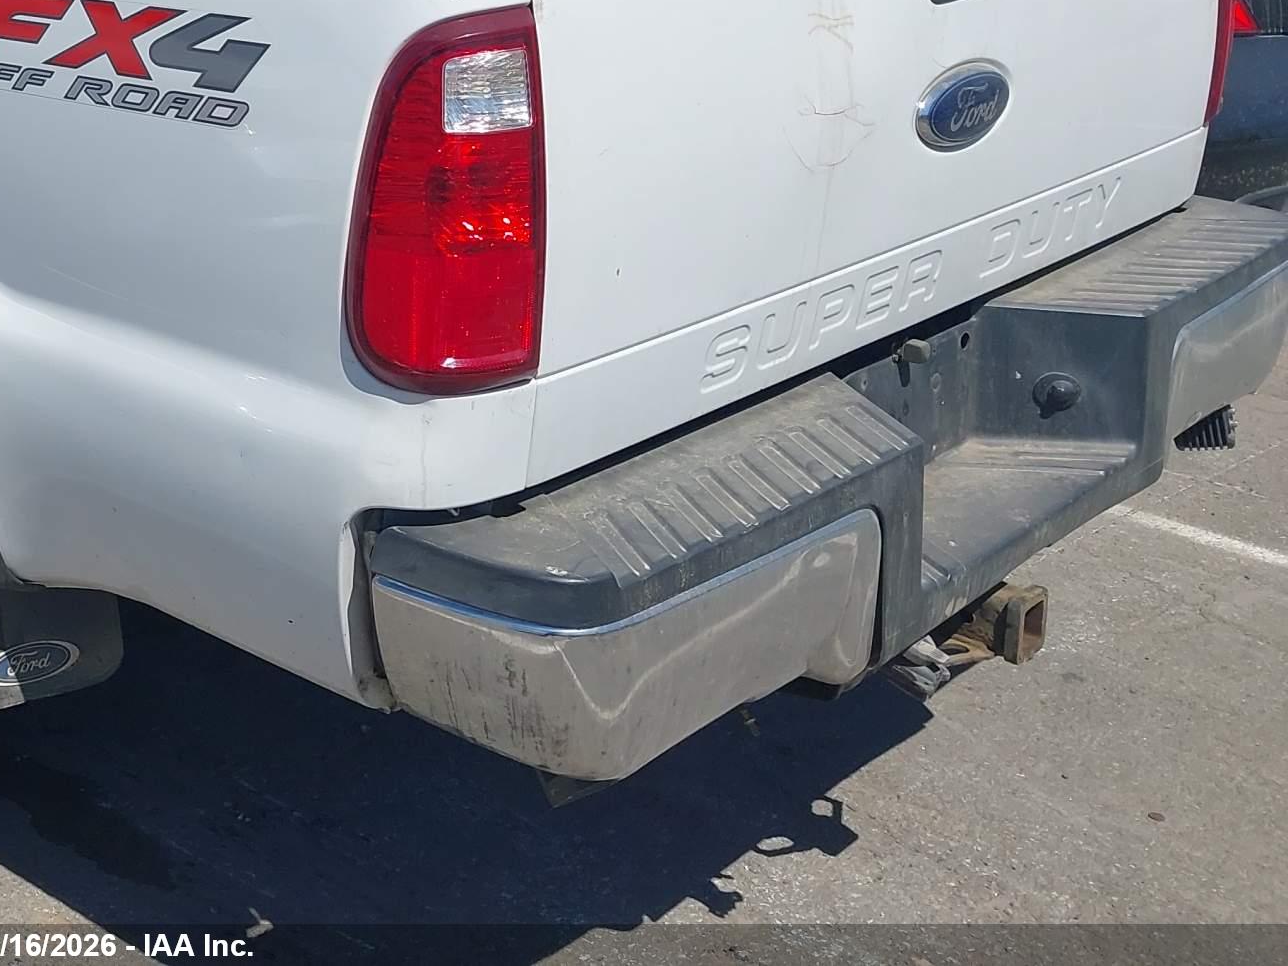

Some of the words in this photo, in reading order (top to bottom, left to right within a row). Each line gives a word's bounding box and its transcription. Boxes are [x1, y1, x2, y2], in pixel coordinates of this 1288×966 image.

[64, 76, 250, 128] ROAD
[951, 83, 1000, 131] Ford
[699, 249, 943, 394] SUPER
[979, 176, 1122, 279] DUTY
[7, 650, 50, 676] Ford
